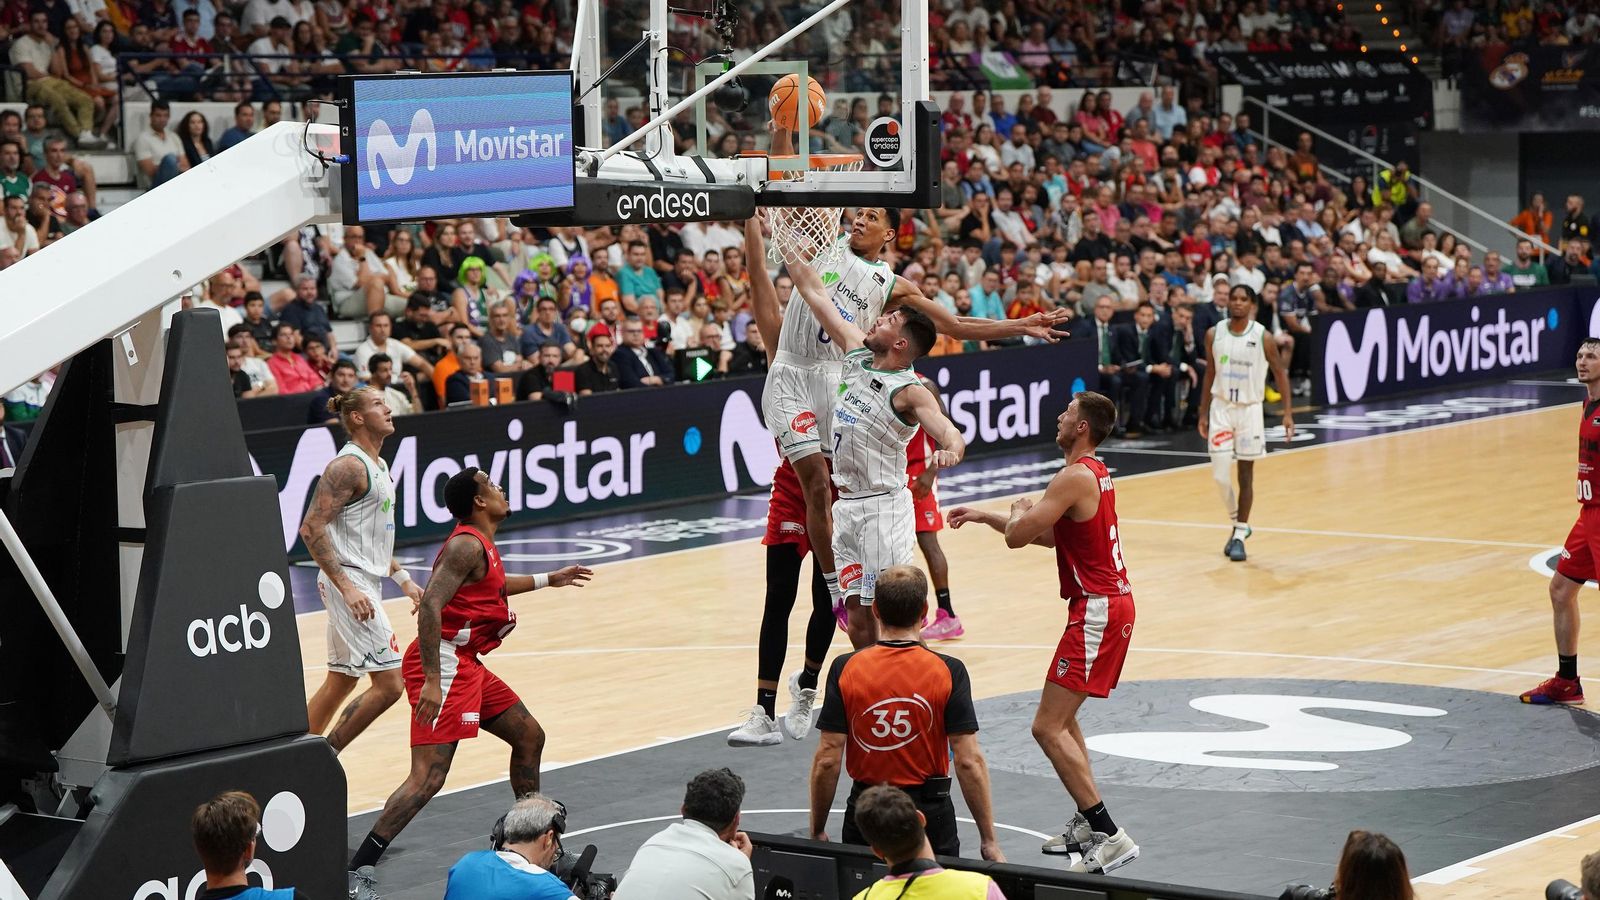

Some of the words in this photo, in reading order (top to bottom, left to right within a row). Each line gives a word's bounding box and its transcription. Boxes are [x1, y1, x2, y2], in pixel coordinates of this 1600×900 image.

[454, 126, 564, 162] Movistar
[616, 186, 710, 220] endesa
[836, 281, 869, 311] Unicaja
[1396, 305, 1545, 382] Movistar
[844, 391, 872, 414] Unicaja
[938, 367, 1050, 446] istar
[1229, 388, 1239, 402] 11
[833, 432, 842, 453] 7
[187, 604, 271, 657] acb
[871, 709, 912, 738] 35
